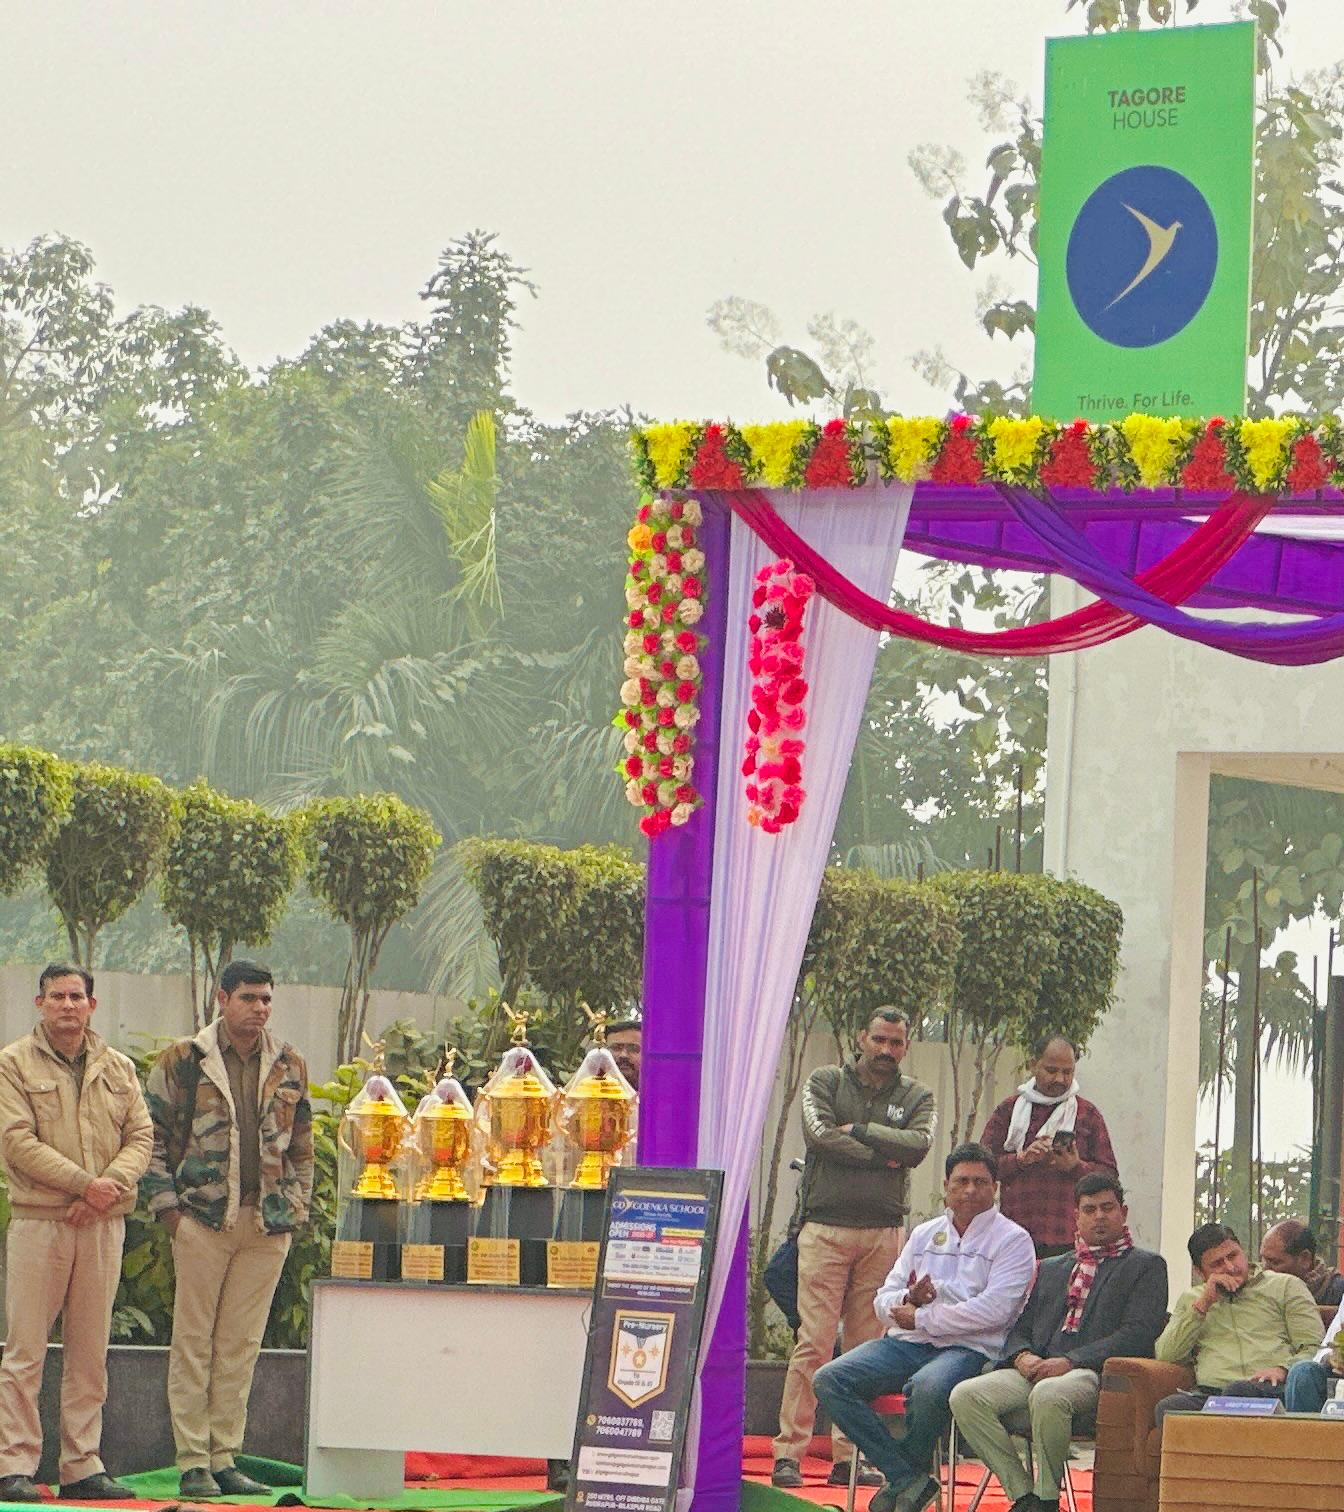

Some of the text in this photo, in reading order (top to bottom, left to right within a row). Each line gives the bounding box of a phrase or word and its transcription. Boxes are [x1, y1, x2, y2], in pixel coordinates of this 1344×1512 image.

[1107, 86, 1186, 108] TAGORE
[1113, 108, 1178, 130] HOUSE
[1077, 390, 1194, 411] Thrive. For Life.
[669, 1204, 705, 1214] SCHOOL
